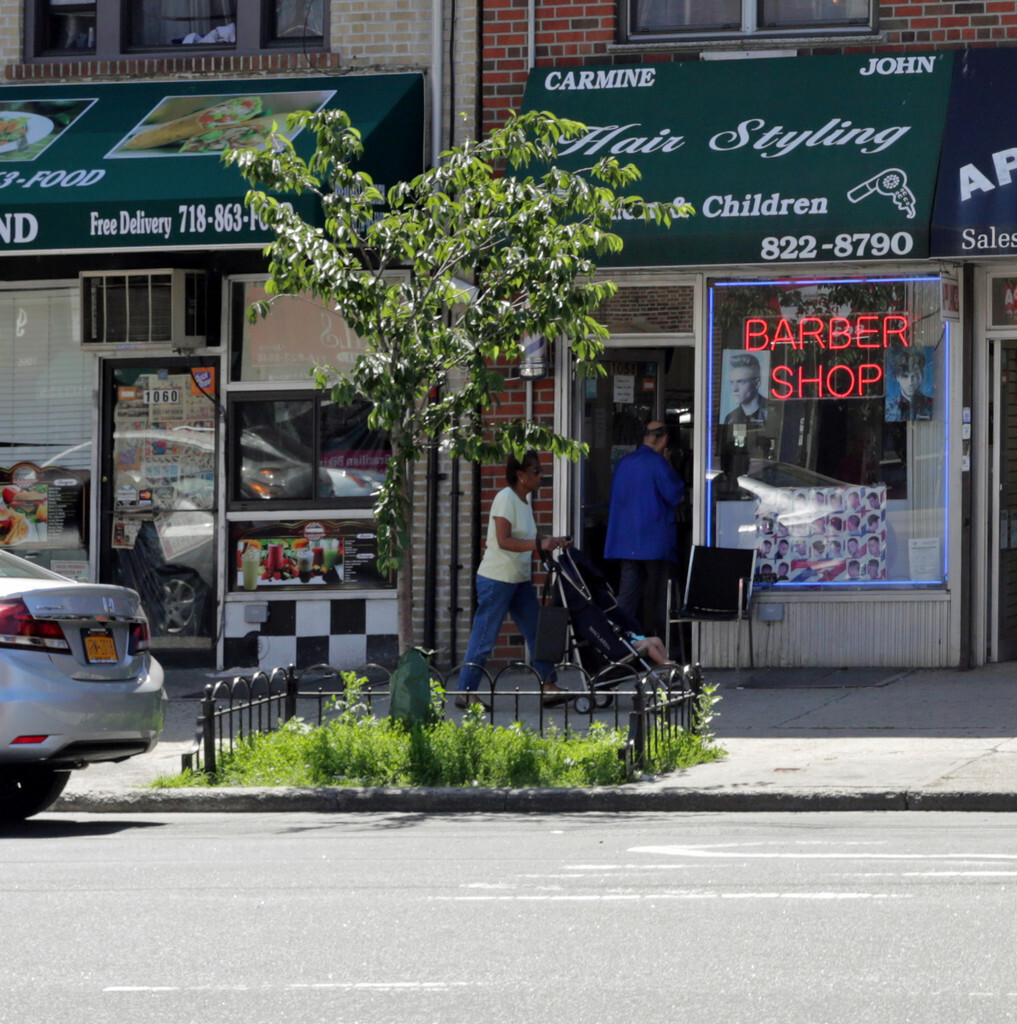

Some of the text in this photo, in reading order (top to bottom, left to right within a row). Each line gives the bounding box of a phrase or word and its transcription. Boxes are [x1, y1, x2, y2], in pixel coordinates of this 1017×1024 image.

[544, 55, 937, 91] CARMINE JOHN
[557, 118, 912, 159] Hair Styling
[702, 193, 828, 218] Children
[90, 210, 118, 238] Free
[119, 208, 172, 239] Delivery
[760, 231, 914, 260] 822-8790
[744, 315, 910, 352] BARBER
[145, 389, 178, 403] 1060
[770, 363, 884, 400] SHOP
